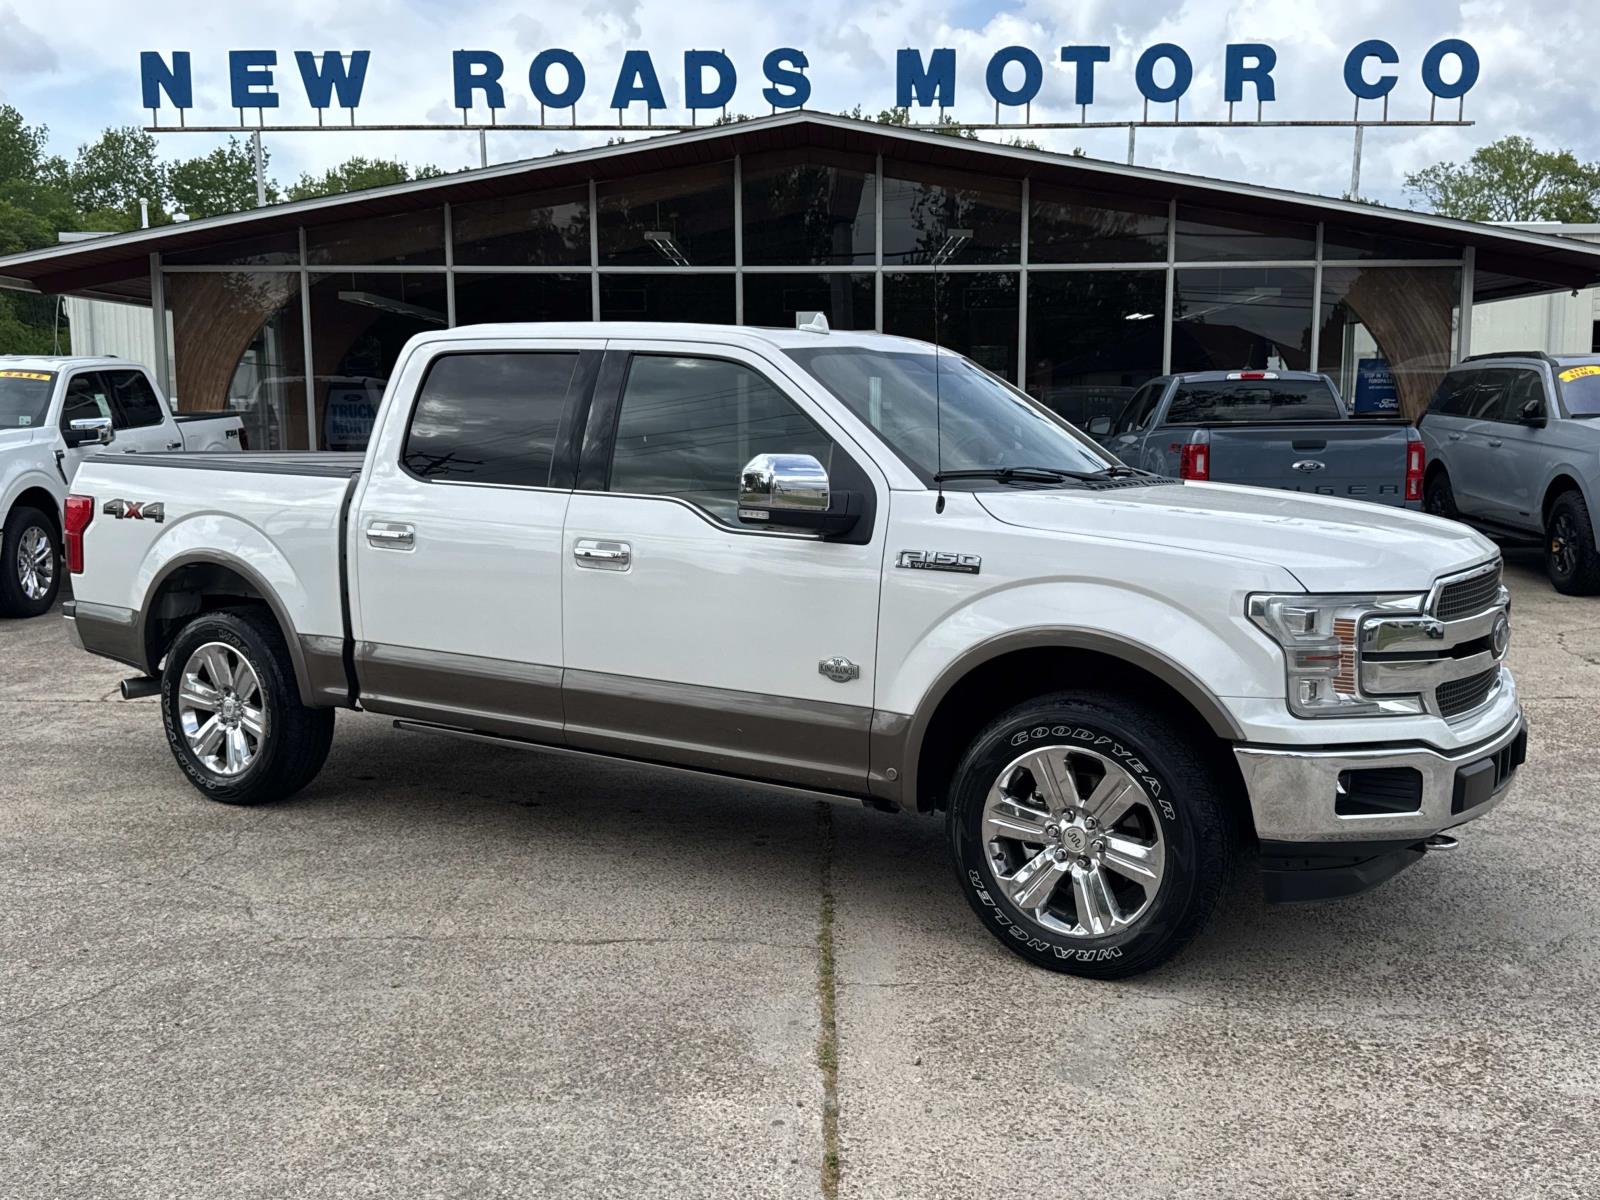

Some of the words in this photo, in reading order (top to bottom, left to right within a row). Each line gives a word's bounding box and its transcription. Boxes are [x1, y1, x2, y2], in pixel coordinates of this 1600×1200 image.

[140, 50, 370, 109] NEW
[452, 47, 811, 110] ROADS
[896, 43, 1277, 108] MOTOR
[1343, 39, 1479, 100] CO
[332, 419, 374, 434] MONT
[820, 663, 835, 673] KING
[1010, 725, 1176, 821] GOODYEAR
[968, 869, 1123, 962] WRANGLER
